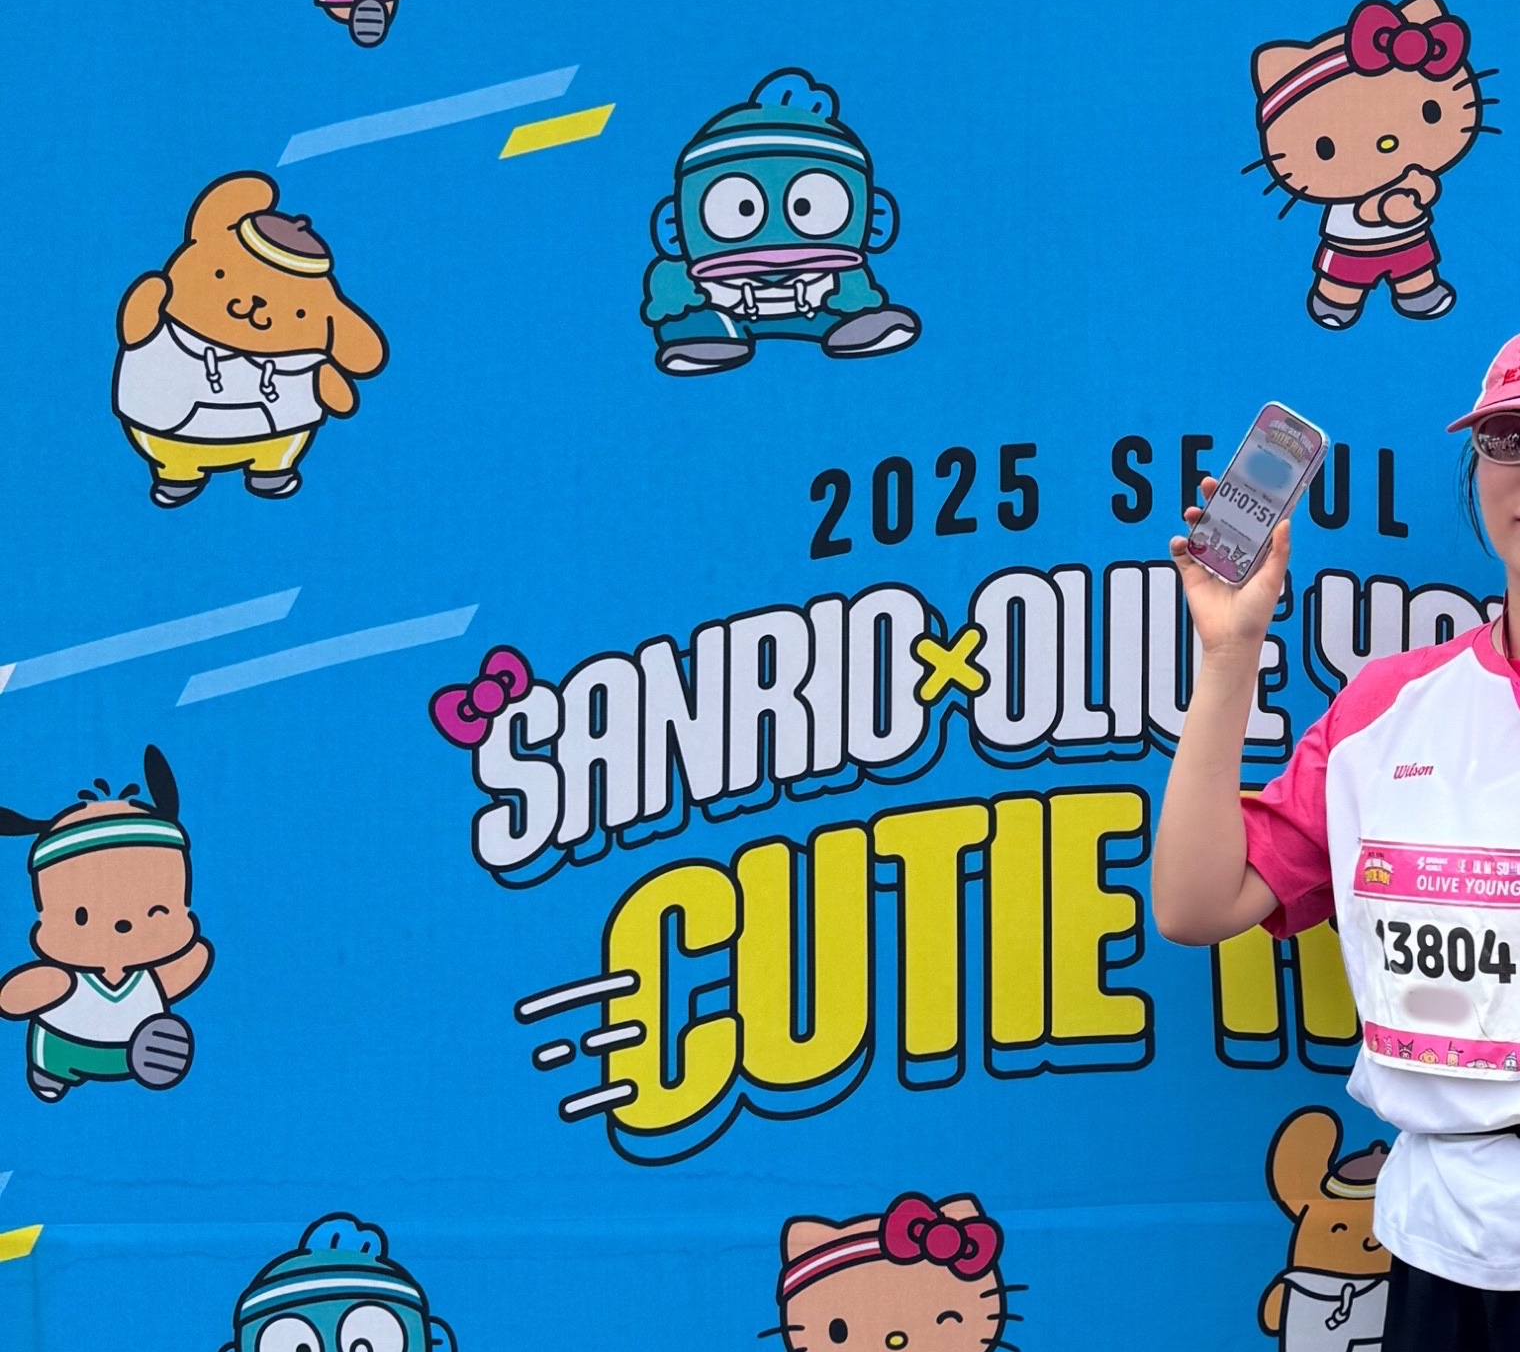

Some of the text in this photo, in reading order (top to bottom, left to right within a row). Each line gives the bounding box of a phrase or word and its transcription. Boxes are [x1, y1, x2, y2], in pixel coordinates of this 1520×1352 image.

[809, 435, 1409, 560] 2025 SEUL
[1219, 481, 1277, 528] 01:07:51
[475, 583, 930, 870] SANRIO
[1393, 762, 1435, 780] Wilson
[1416, 874, 1460, 893] OLIVE
[602, 787, 1153, 1136] CUTIE
[1375, 918, 1517, 984] 13804
